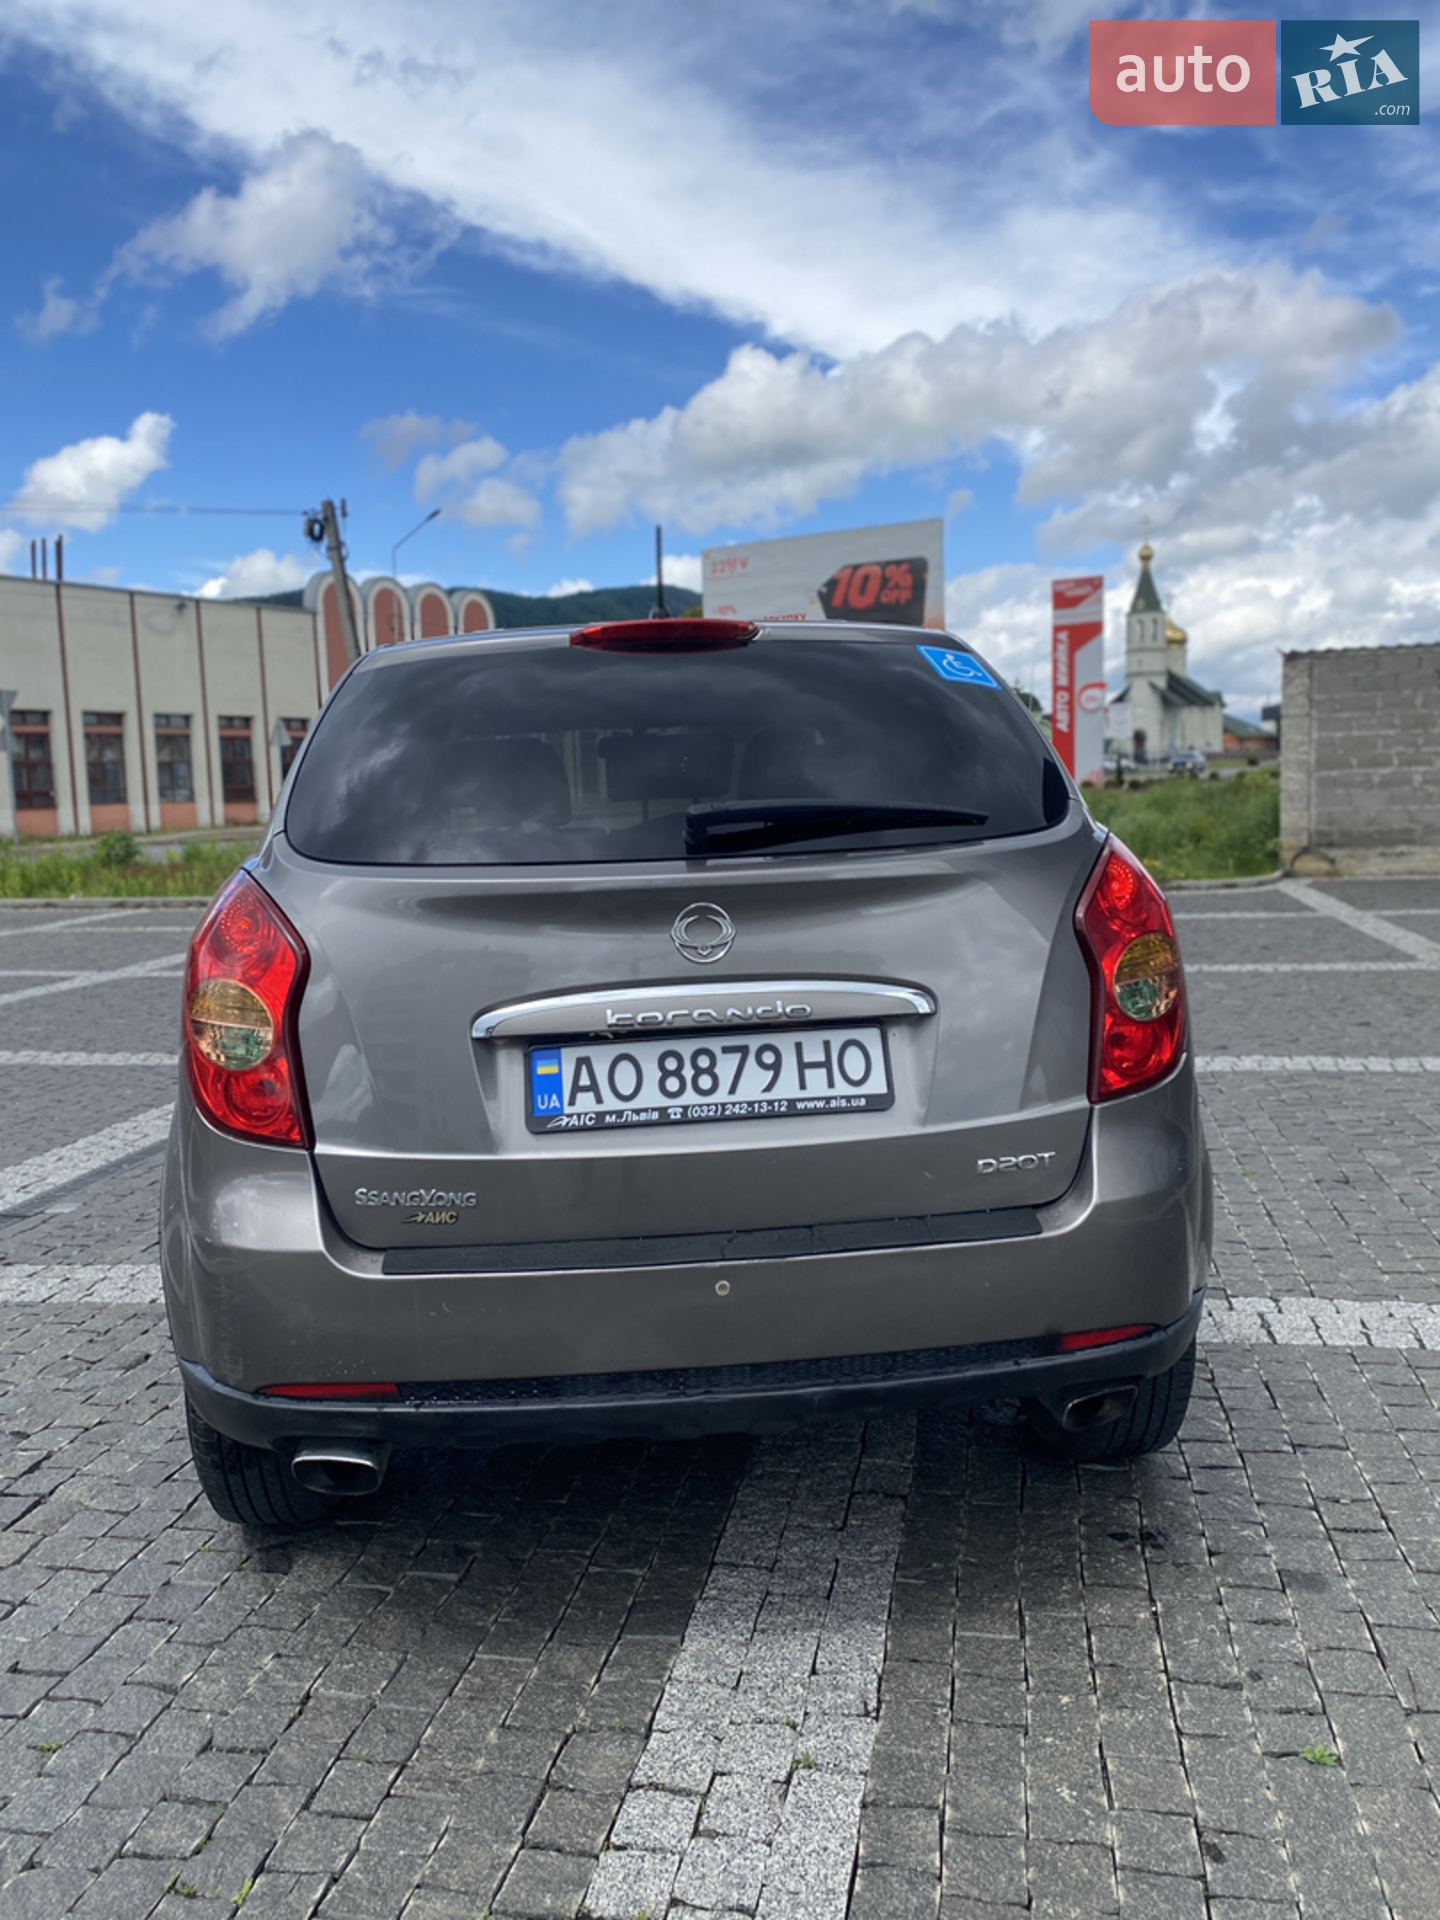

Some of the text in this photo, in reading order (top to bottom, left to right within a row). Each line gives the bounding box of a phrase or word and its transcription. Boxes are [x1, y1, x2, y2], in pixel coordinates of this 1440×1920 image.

[831, 562, 914, 609] 10%
[657, 1042, 783, 1099] 8879
[537, 1094, 561, 1110] UA
[687, 1104, 721, 1119] (032)
[724, 1100, 788, 1115] 242-13-12
[796, 1096, 866, 1110] www.ais.ua
[977, 1151, 1056, 1174] D20T
